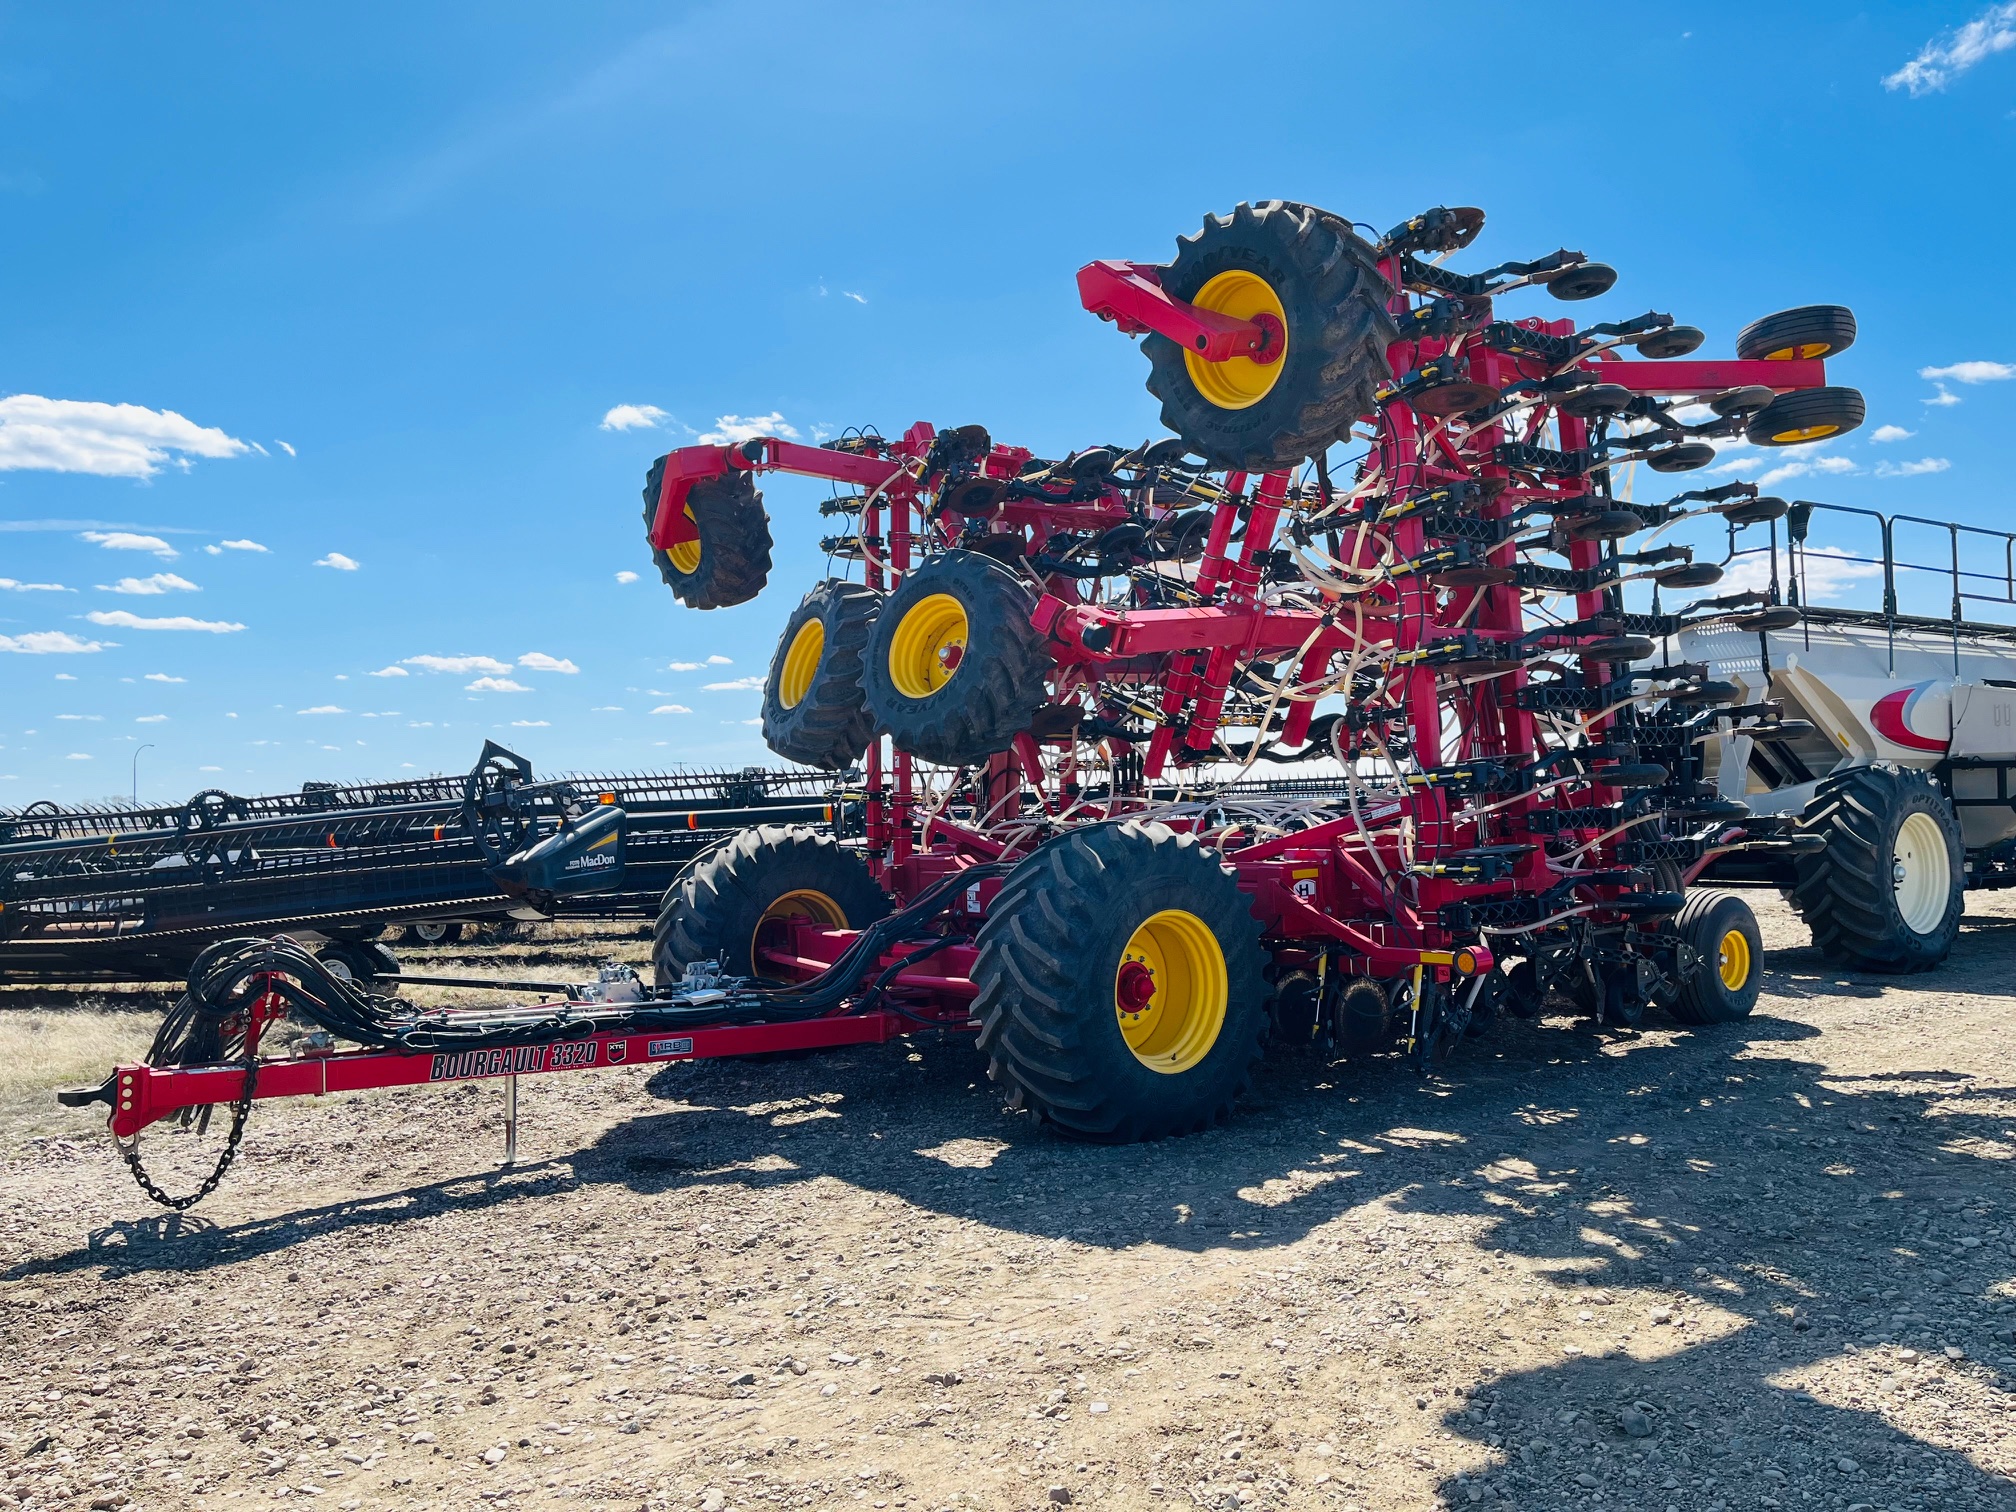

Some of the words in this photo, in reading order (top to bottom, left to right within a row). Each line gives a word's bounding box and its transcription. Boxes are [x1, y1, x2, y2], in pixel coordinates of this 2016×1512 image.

[1911, 793, 1955, 837] OPTITRAC
[580, 853, 616, 868] MacDon
[609, 1043, 625, 1051] XTC
[429, 1045, 548, 1082] BOURGAULT
[550, 1041, 599, 1067] 3320
